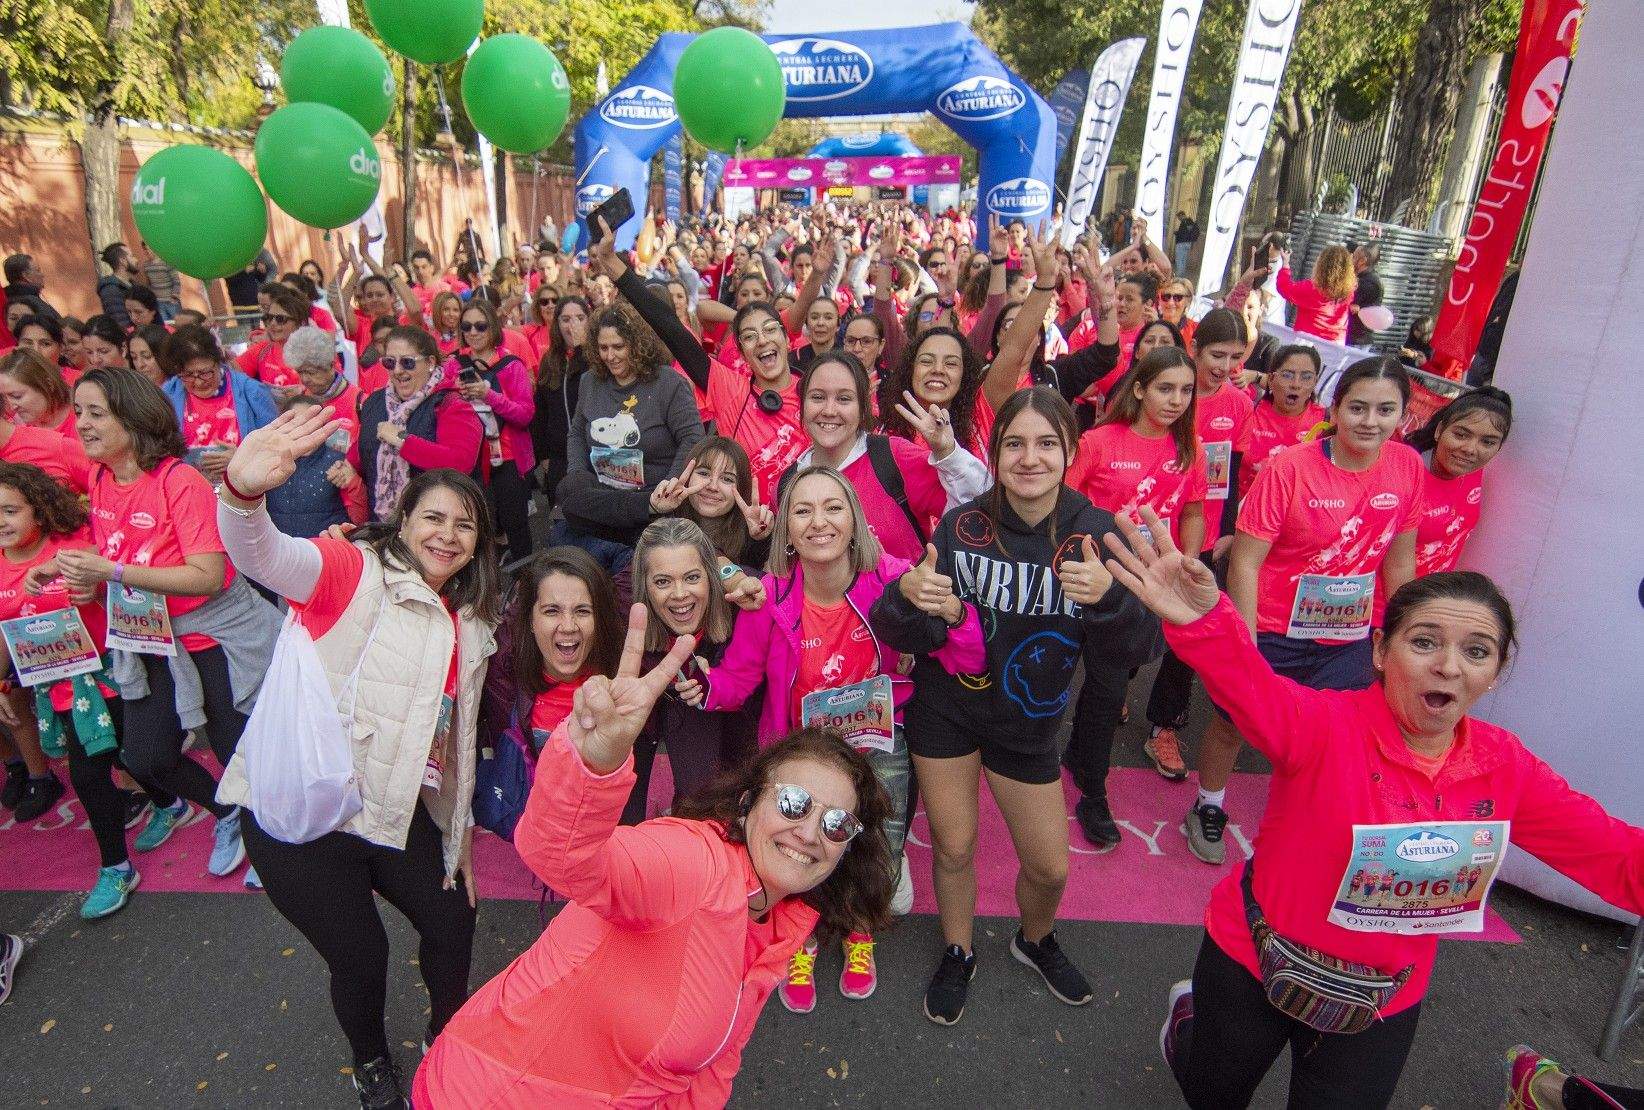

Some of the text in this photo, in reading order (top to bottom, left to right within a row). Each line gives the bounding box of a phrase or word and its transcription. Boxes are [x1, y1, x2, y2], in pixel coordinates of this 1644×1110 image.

[782, 65, 862, 85] TURIANA
[944, 94, 1020, 112] ASTURIANA
[1141, 8, 1190, 216] OYSHO
[1070, 80, 1121, 225] OYSHO
[1110, 461, 1141, 470] OYSHO
[1309, 499, 1345, 508] OYSHO
[953, 550, 1083, 618] NIRVA
[1323, 605, 1354, 616] 016
[801, 637, 822, 648] SHO
[832, 711, 866, 726] 016
[1400, 844, 1456, 857] ASTURIANA
[1393, 880, 1450, 897] 016
[1356, 907, 1388, 916] CARRERA
[1440, 906, 1465, 915] SEVILLA
[1401, 900, 1429, 909] 2875
[1346, 916, 1465, 929] OYSHO Santander
